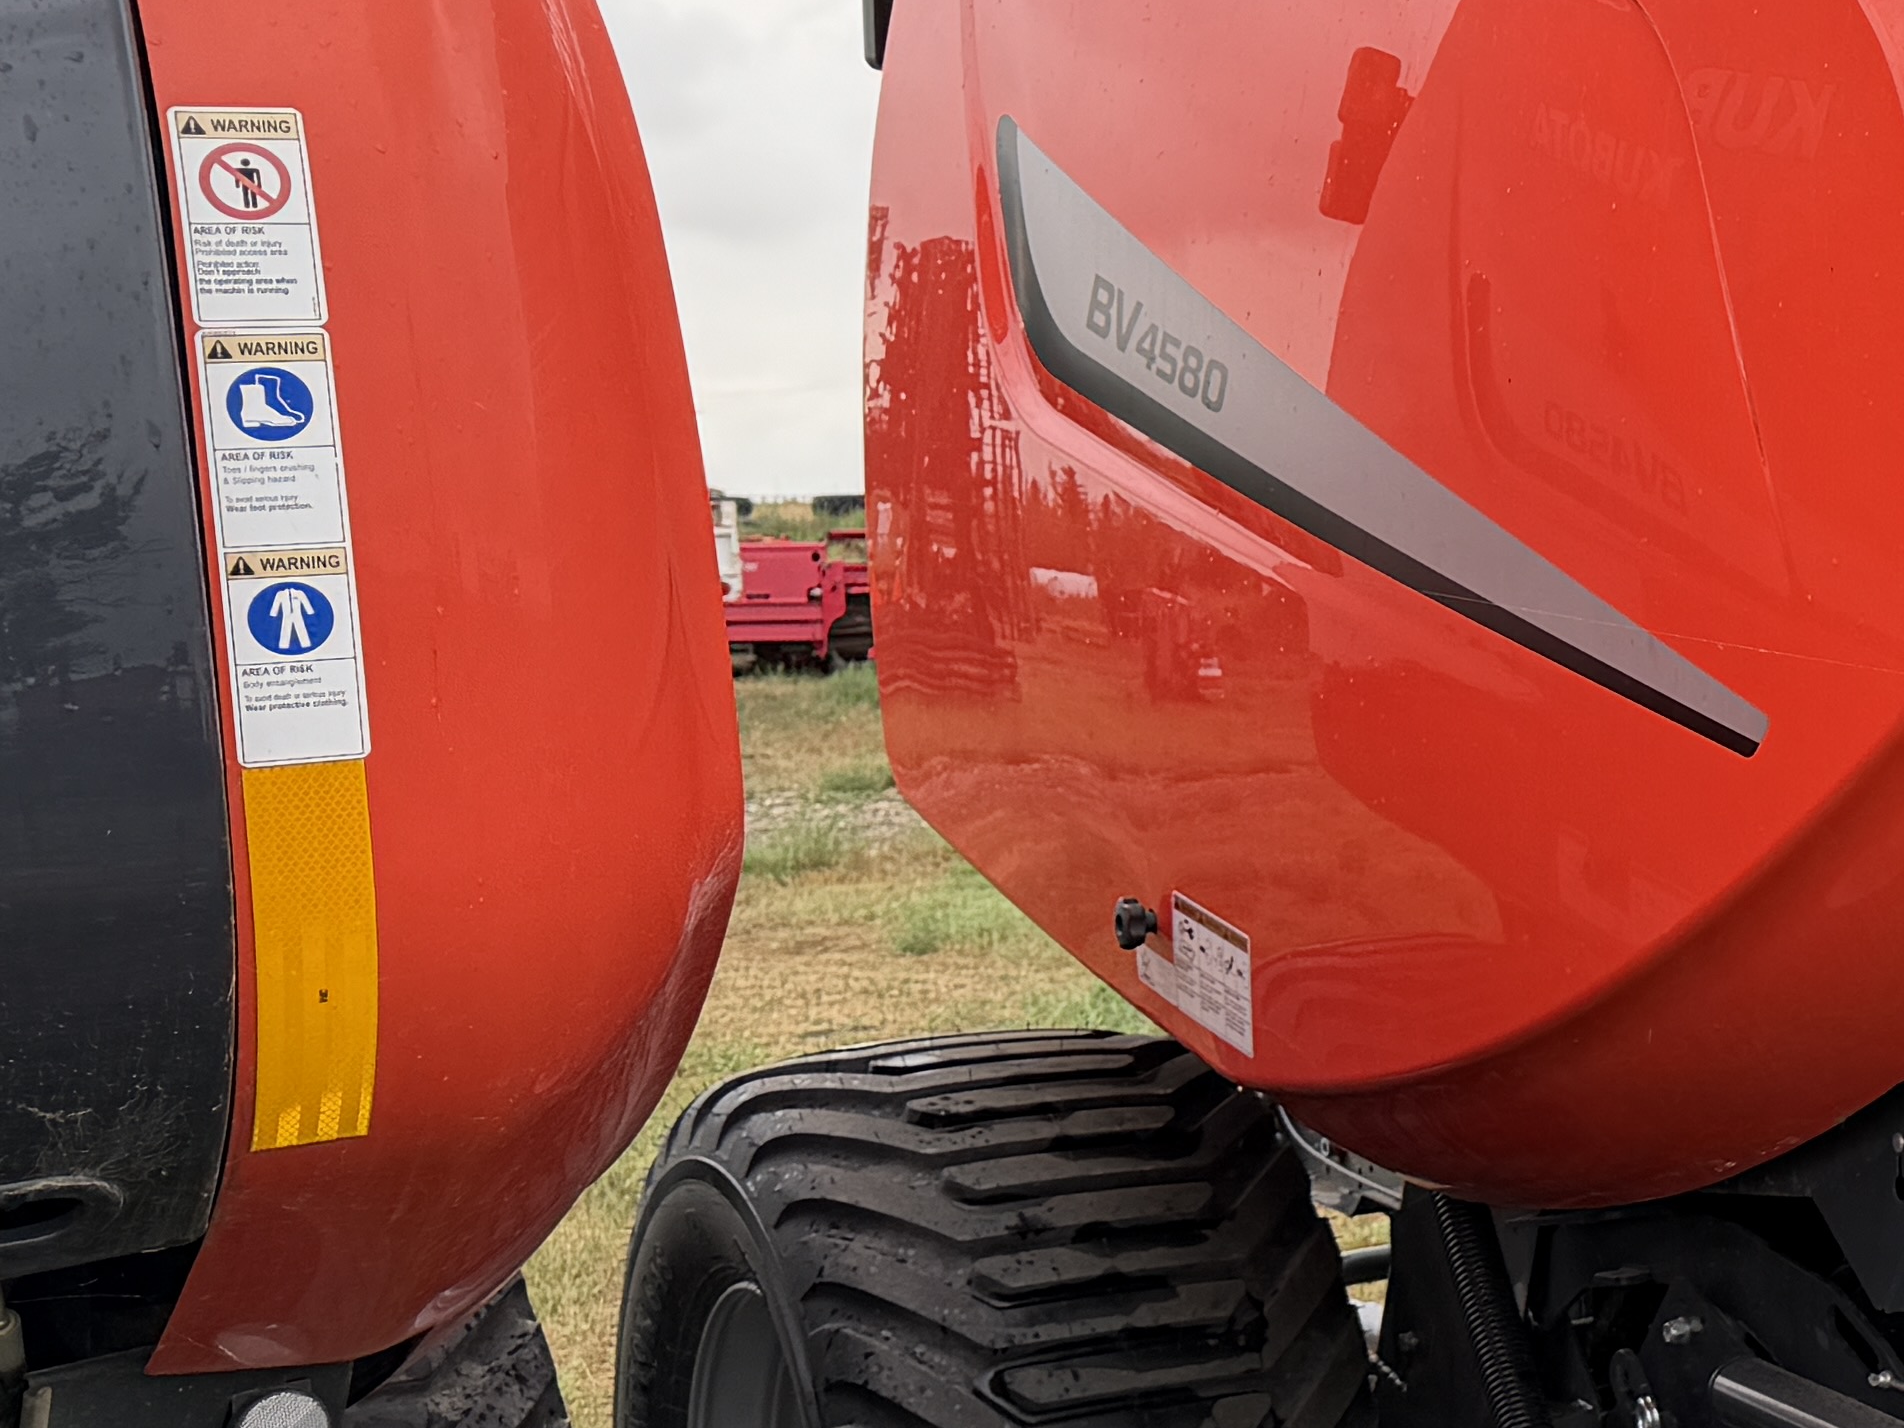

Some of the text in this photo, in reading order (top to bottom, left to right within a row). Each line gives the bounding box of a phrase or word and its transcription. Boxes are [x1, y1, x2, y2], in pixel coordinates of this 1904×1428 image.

[210, 118, 291, 133] WARNING
[193, 226, 265, 236] AREA OF RISK
[238, 340, 319, 356] WARNING
[1086, 273, 1229, 413] BV4580
[220, 450, 294, 462] AREA OF RISK
[260, 555, 340, 571] WARNING
[242, 664, 314, 677] AREA OF RISK
